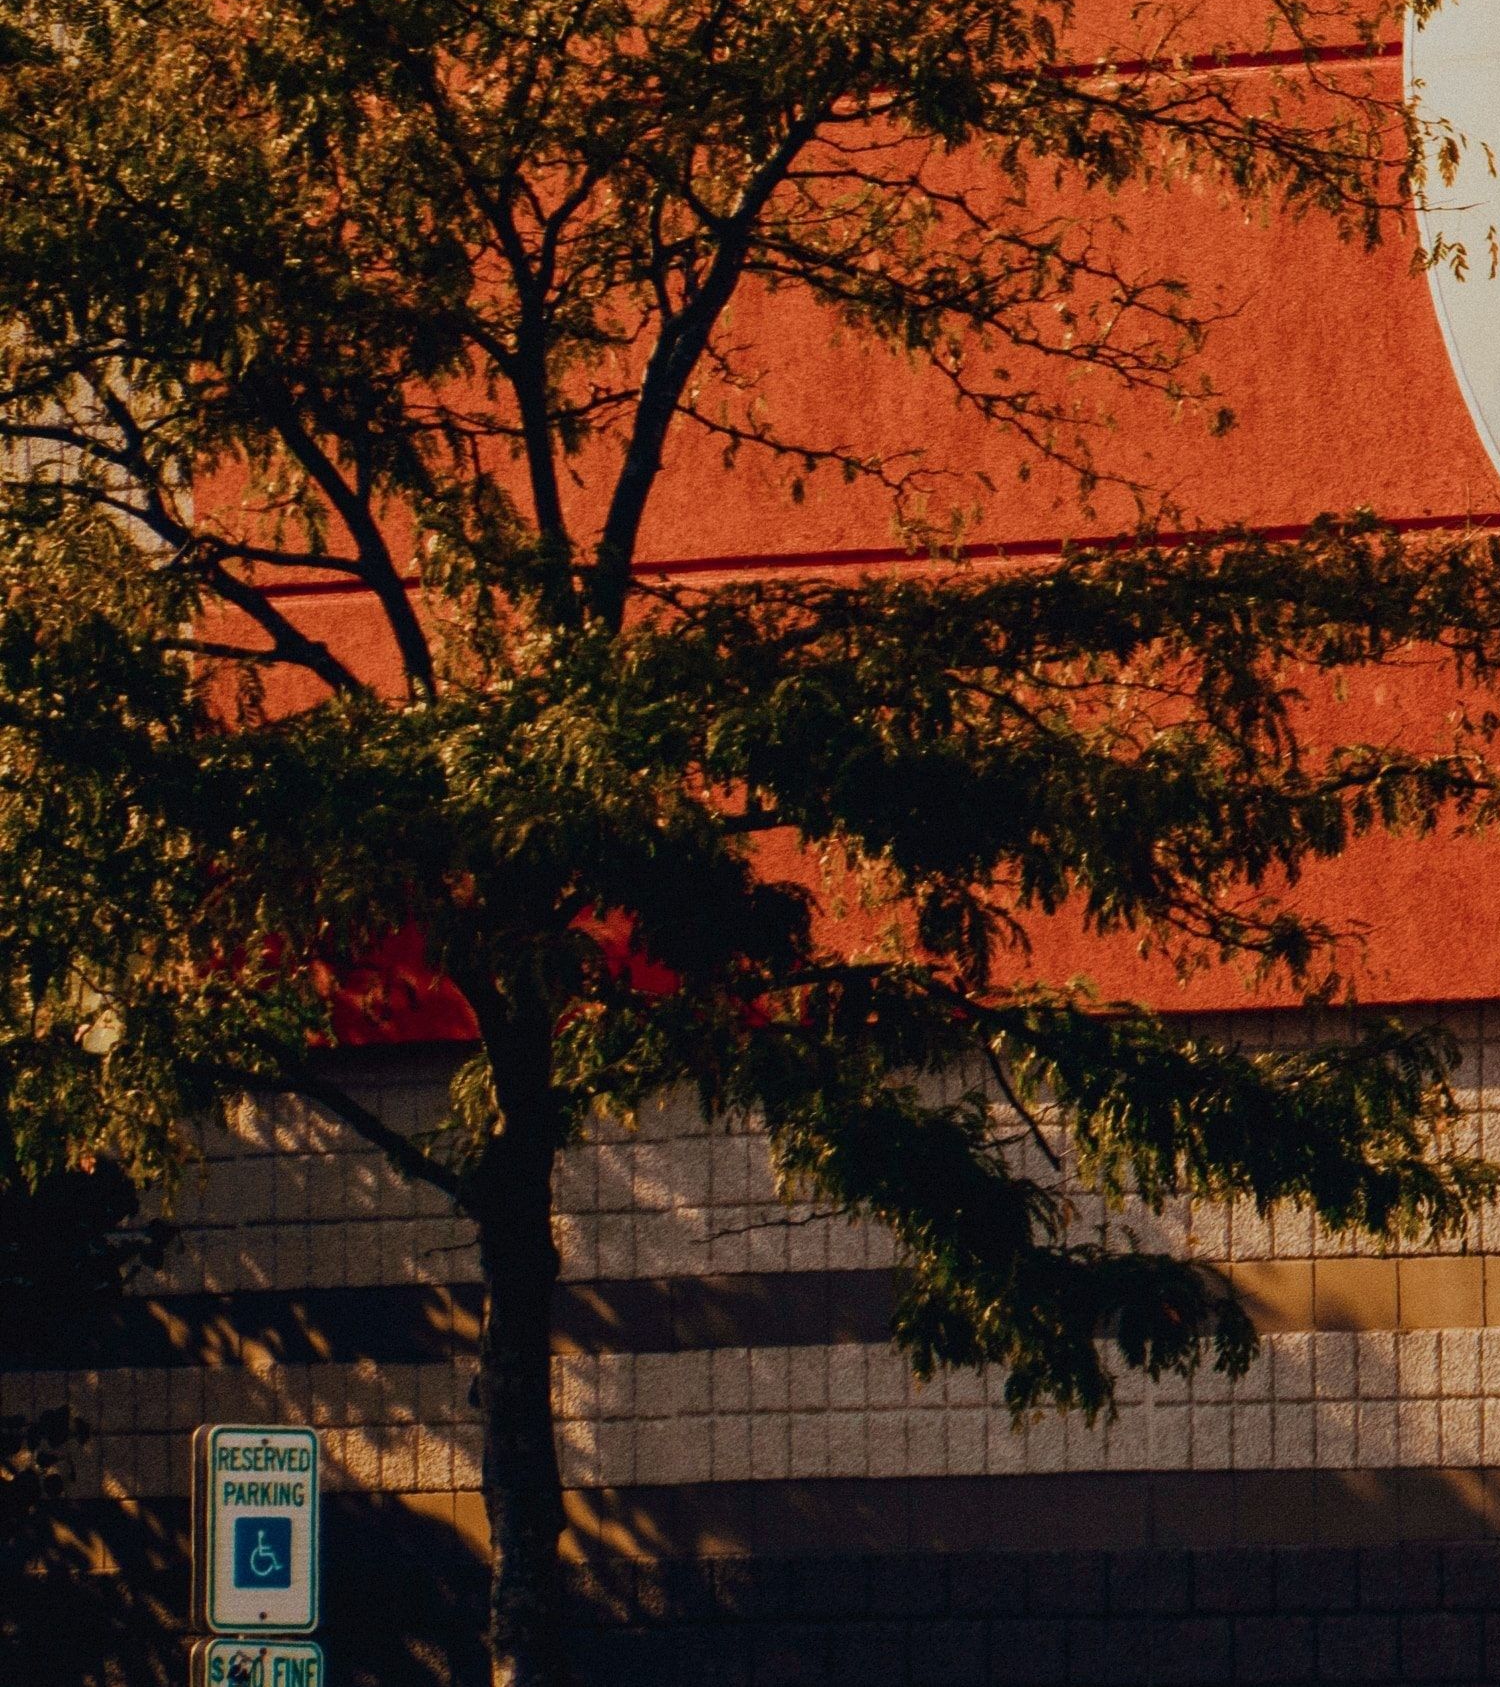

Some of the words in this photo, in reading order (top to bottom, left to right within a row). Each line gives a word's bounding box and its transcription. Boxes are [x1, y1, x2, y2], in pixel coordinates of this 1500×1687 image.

[217, 1446, 311, 1472] RESERVED
[223, 1481, 305, 1507] PARKING
[272, 1656, 318, 1687] FINE
